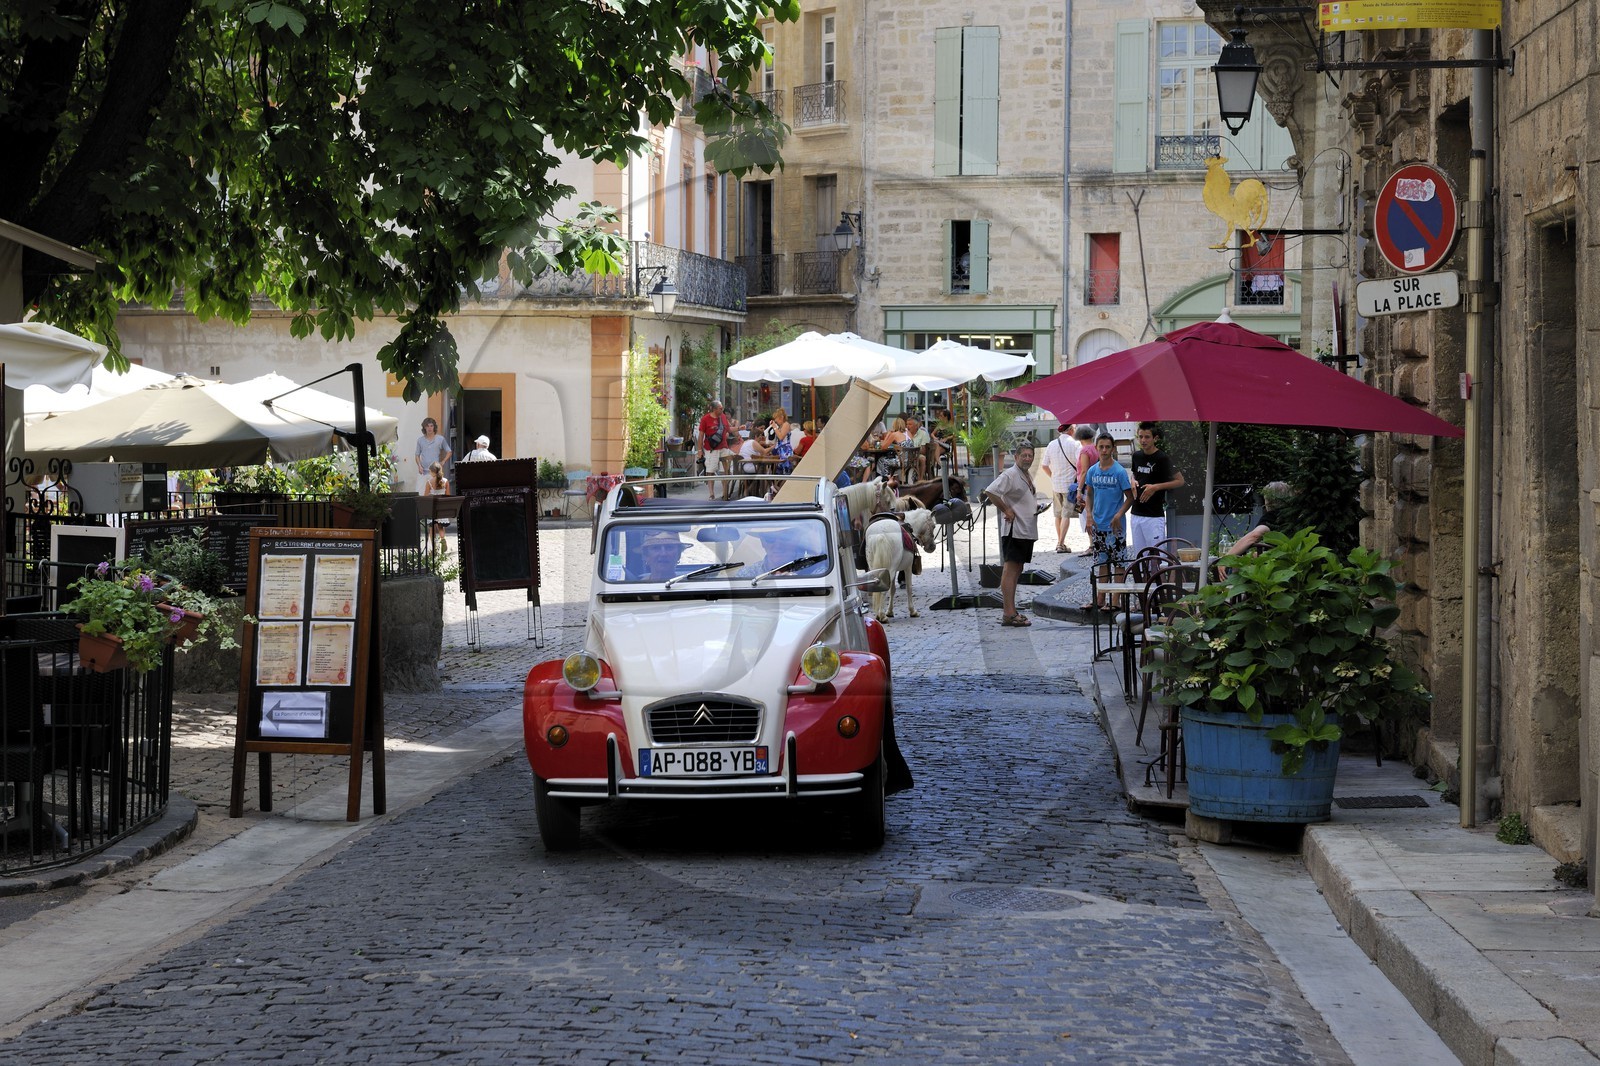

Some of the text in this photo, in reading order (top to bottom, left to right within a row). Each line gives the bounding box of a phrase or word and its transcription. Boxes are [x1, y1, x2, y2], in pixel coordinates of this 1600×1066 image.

[1393, 278, 1420, 293] SUR
[1374, 292, 1441, 312] LA PLACE
[643, 764, 648, 772] F
[652, 751, 754, 772] AP-088-YB
[756, 761, 766, 771] 34
